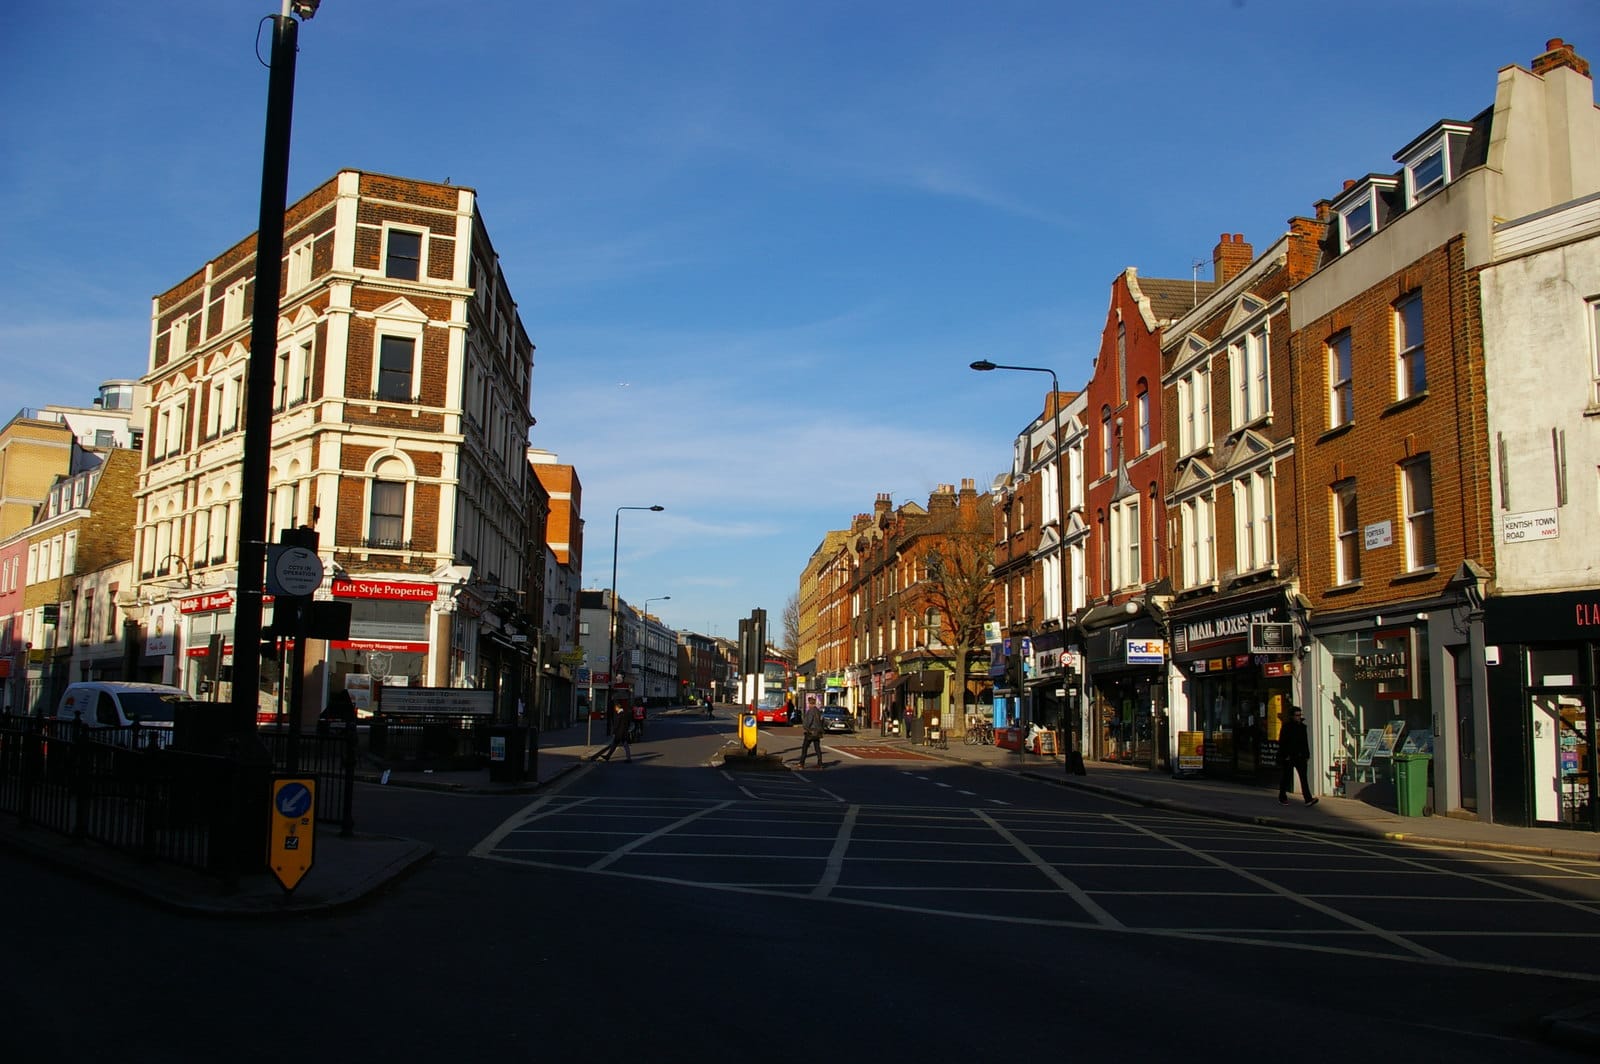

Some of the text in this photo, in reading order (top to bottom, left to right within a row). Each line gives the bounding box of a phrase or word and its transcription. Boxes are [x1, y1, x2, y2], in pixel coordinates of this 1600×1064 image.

[1505, 517, 1556, 530] KENTISH TOWN
[1506, 531, 1525, 539] ROAD
[336, 583, 434, 597] Loft Style Properties
[1188, 620, 1215, 641] MAIL
[1216, 613, 1249, 637] BOXES
[1128, 642, 1160, 653] FedEx
